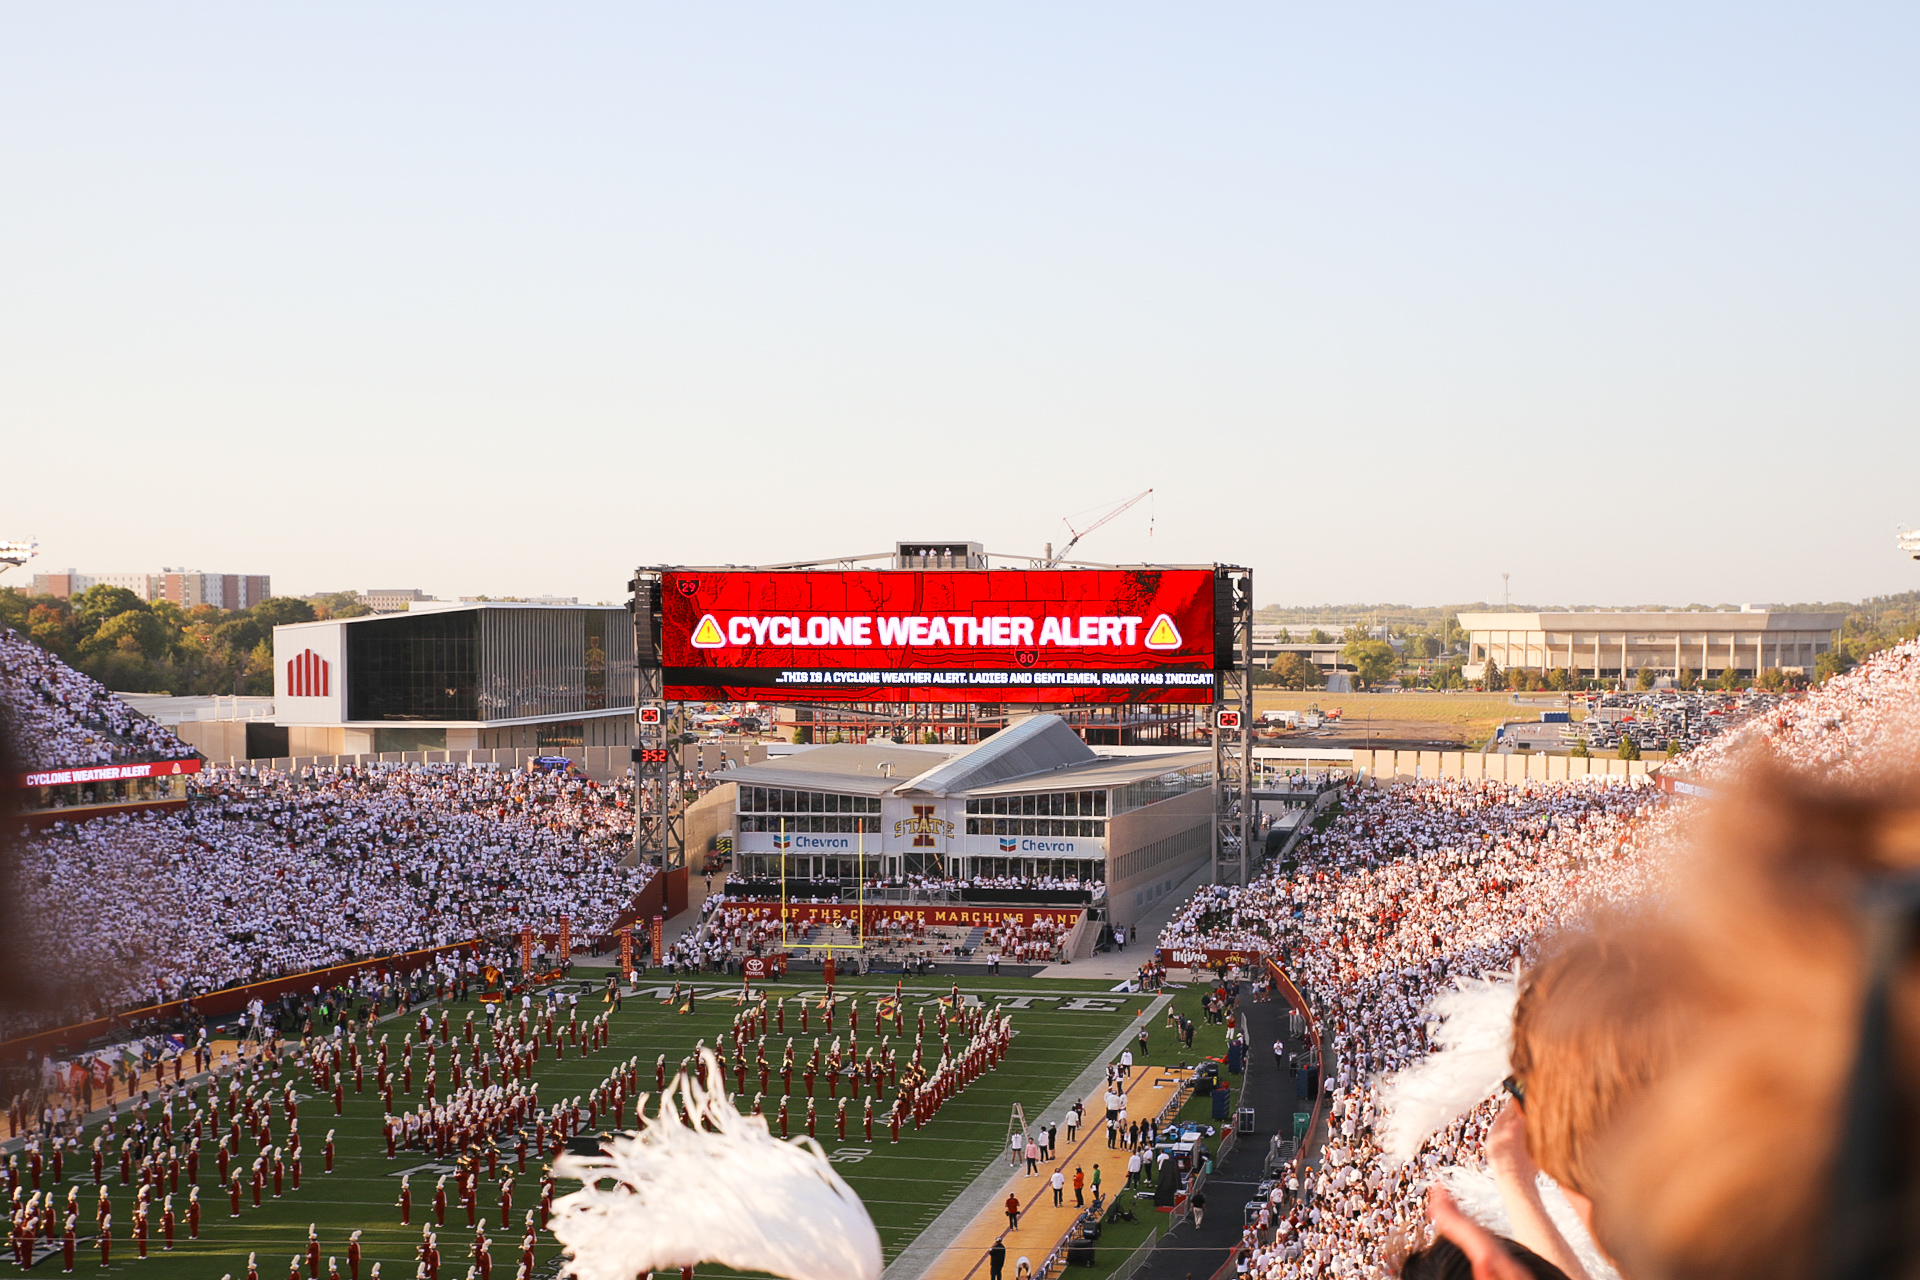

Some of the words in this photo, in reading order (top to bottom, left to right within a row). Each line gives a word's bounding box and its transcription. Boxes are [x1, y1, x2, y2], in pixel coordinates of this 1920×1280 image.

[682, 582, 695, 593] 29
[728, 616, 872, 646] CYCLONE
[877, 616, 1035, 646] WEATHER
[1038, 616, 1143, 646] ALERT
[1019, 653, 1034, 664] 80
[809, 672, 823, 683] IS
[824, 672, 833, 683] A
[833, 672, 880, 683] CYCLONE
[881, 672, 932, 684] WEATHER
[933, 672, 968, 684] ALERT.
[969, 672, 1009, 684] LADIES
[1009, 673, 1033, 684] AND
[1033, 673, 1101, 685] GENTLEMEN,
[1102, 673, 1140, 685] RADAR
[1141, 673, 1164, 685] HAS
[642, 709, 657, 722] 25
[1221, 713, 1237, 726] 25
[642, 749, 666, 762] 3:52
[26, 772, 72, 787] CYCLONE
[72, 768, 121, 783] WEATHER
[121, 765, 152, 779] ALERT
[894, 817, 955, 839] STATE
[795, 835, 849, 848] Chevron
[1021, 839, 1074, 852] Chevron
[780, 908, 800, 918] OF
[809, 908, 841, 919] THE
[935, 911, 1024, 923] MARCHING
